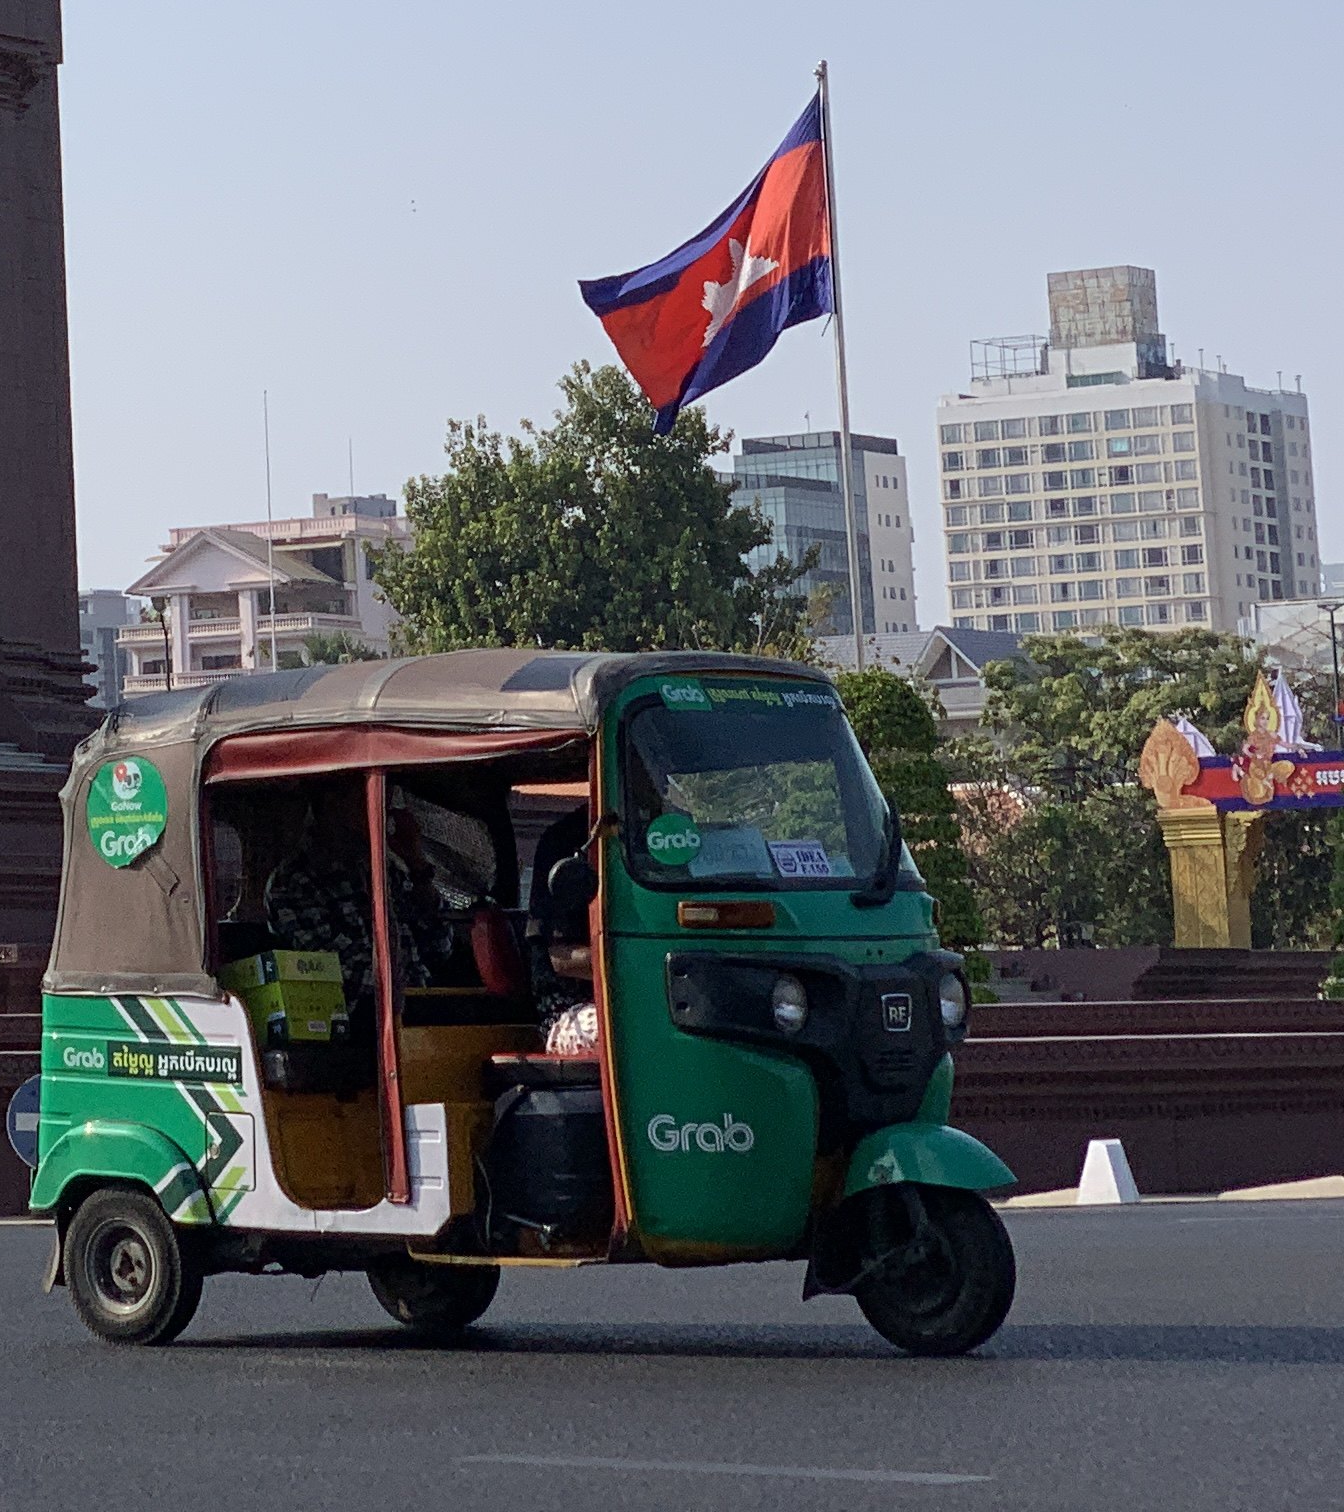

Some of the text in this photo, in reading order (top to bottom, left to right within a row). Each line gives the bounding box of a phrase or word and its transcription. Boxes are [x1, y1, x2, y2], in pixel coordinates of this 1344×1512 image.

[662, 684, 705, 702] Grab
[100, 827, 152, 857] Grab
[646, 829, 701, 850] Grab
[889, 1006, 907, 1023] RE
[63, 1046, 105, 1068] Grab
[647, 1113, 755, 1153] Grab
